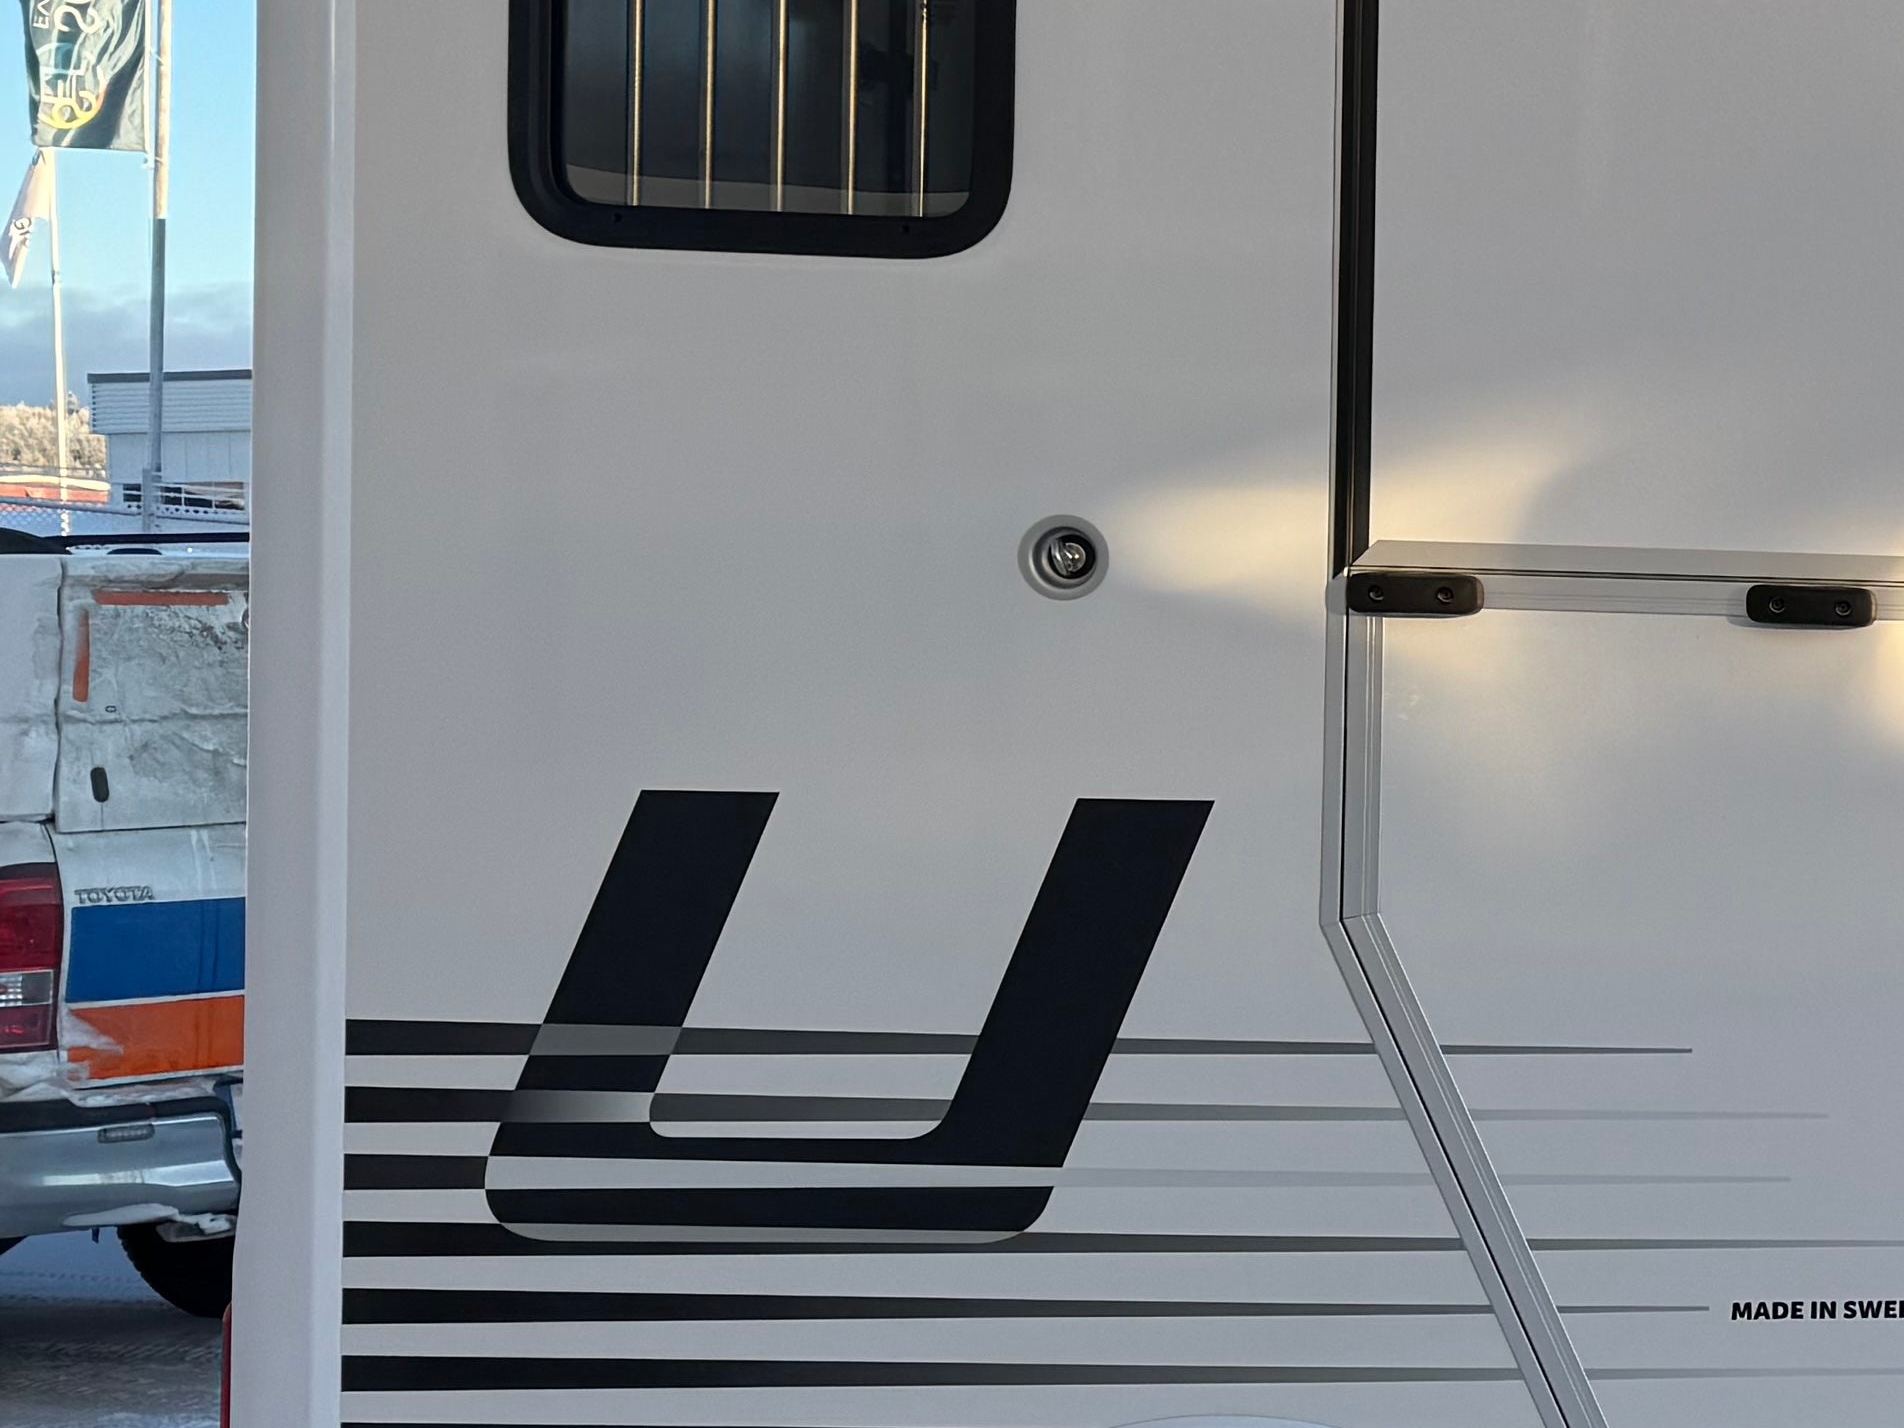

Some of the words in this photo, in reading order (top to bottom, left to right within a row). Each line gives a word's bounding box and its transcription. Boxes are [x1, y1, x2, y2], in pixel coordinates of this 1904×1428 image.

[74, 885, 155, 904] TOYOTA
[1731, 1301, 1804, 1320] MADE
[1810, 1301, 1837, 1319] IN
